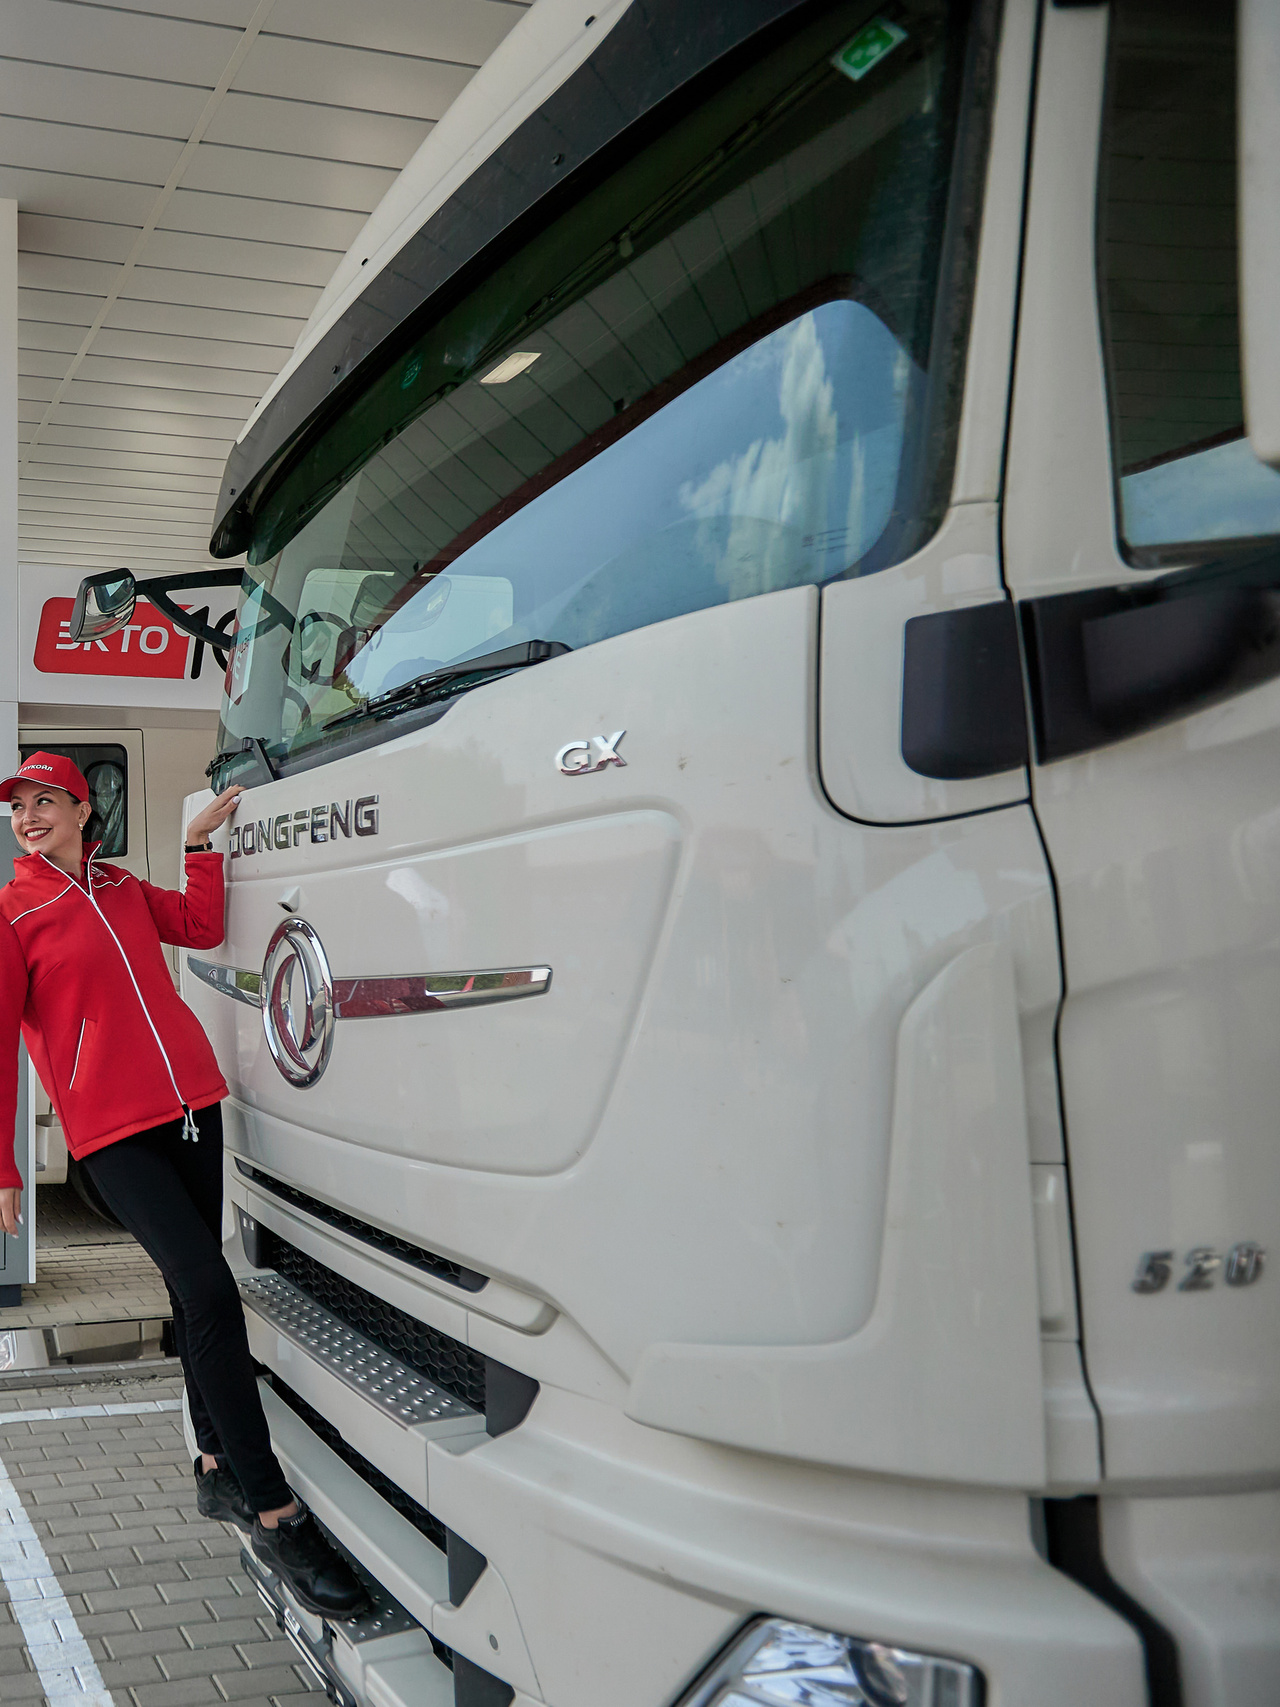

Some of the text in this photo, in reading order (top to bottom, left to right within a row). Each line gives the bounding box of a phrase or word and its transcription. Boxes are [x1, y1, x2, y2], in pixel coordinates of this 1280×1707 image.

[555, 729, 628, 777] GX
[229, 794, 380, 860] DONGFENG
[1130, 1241, 1266, 1295] 520
